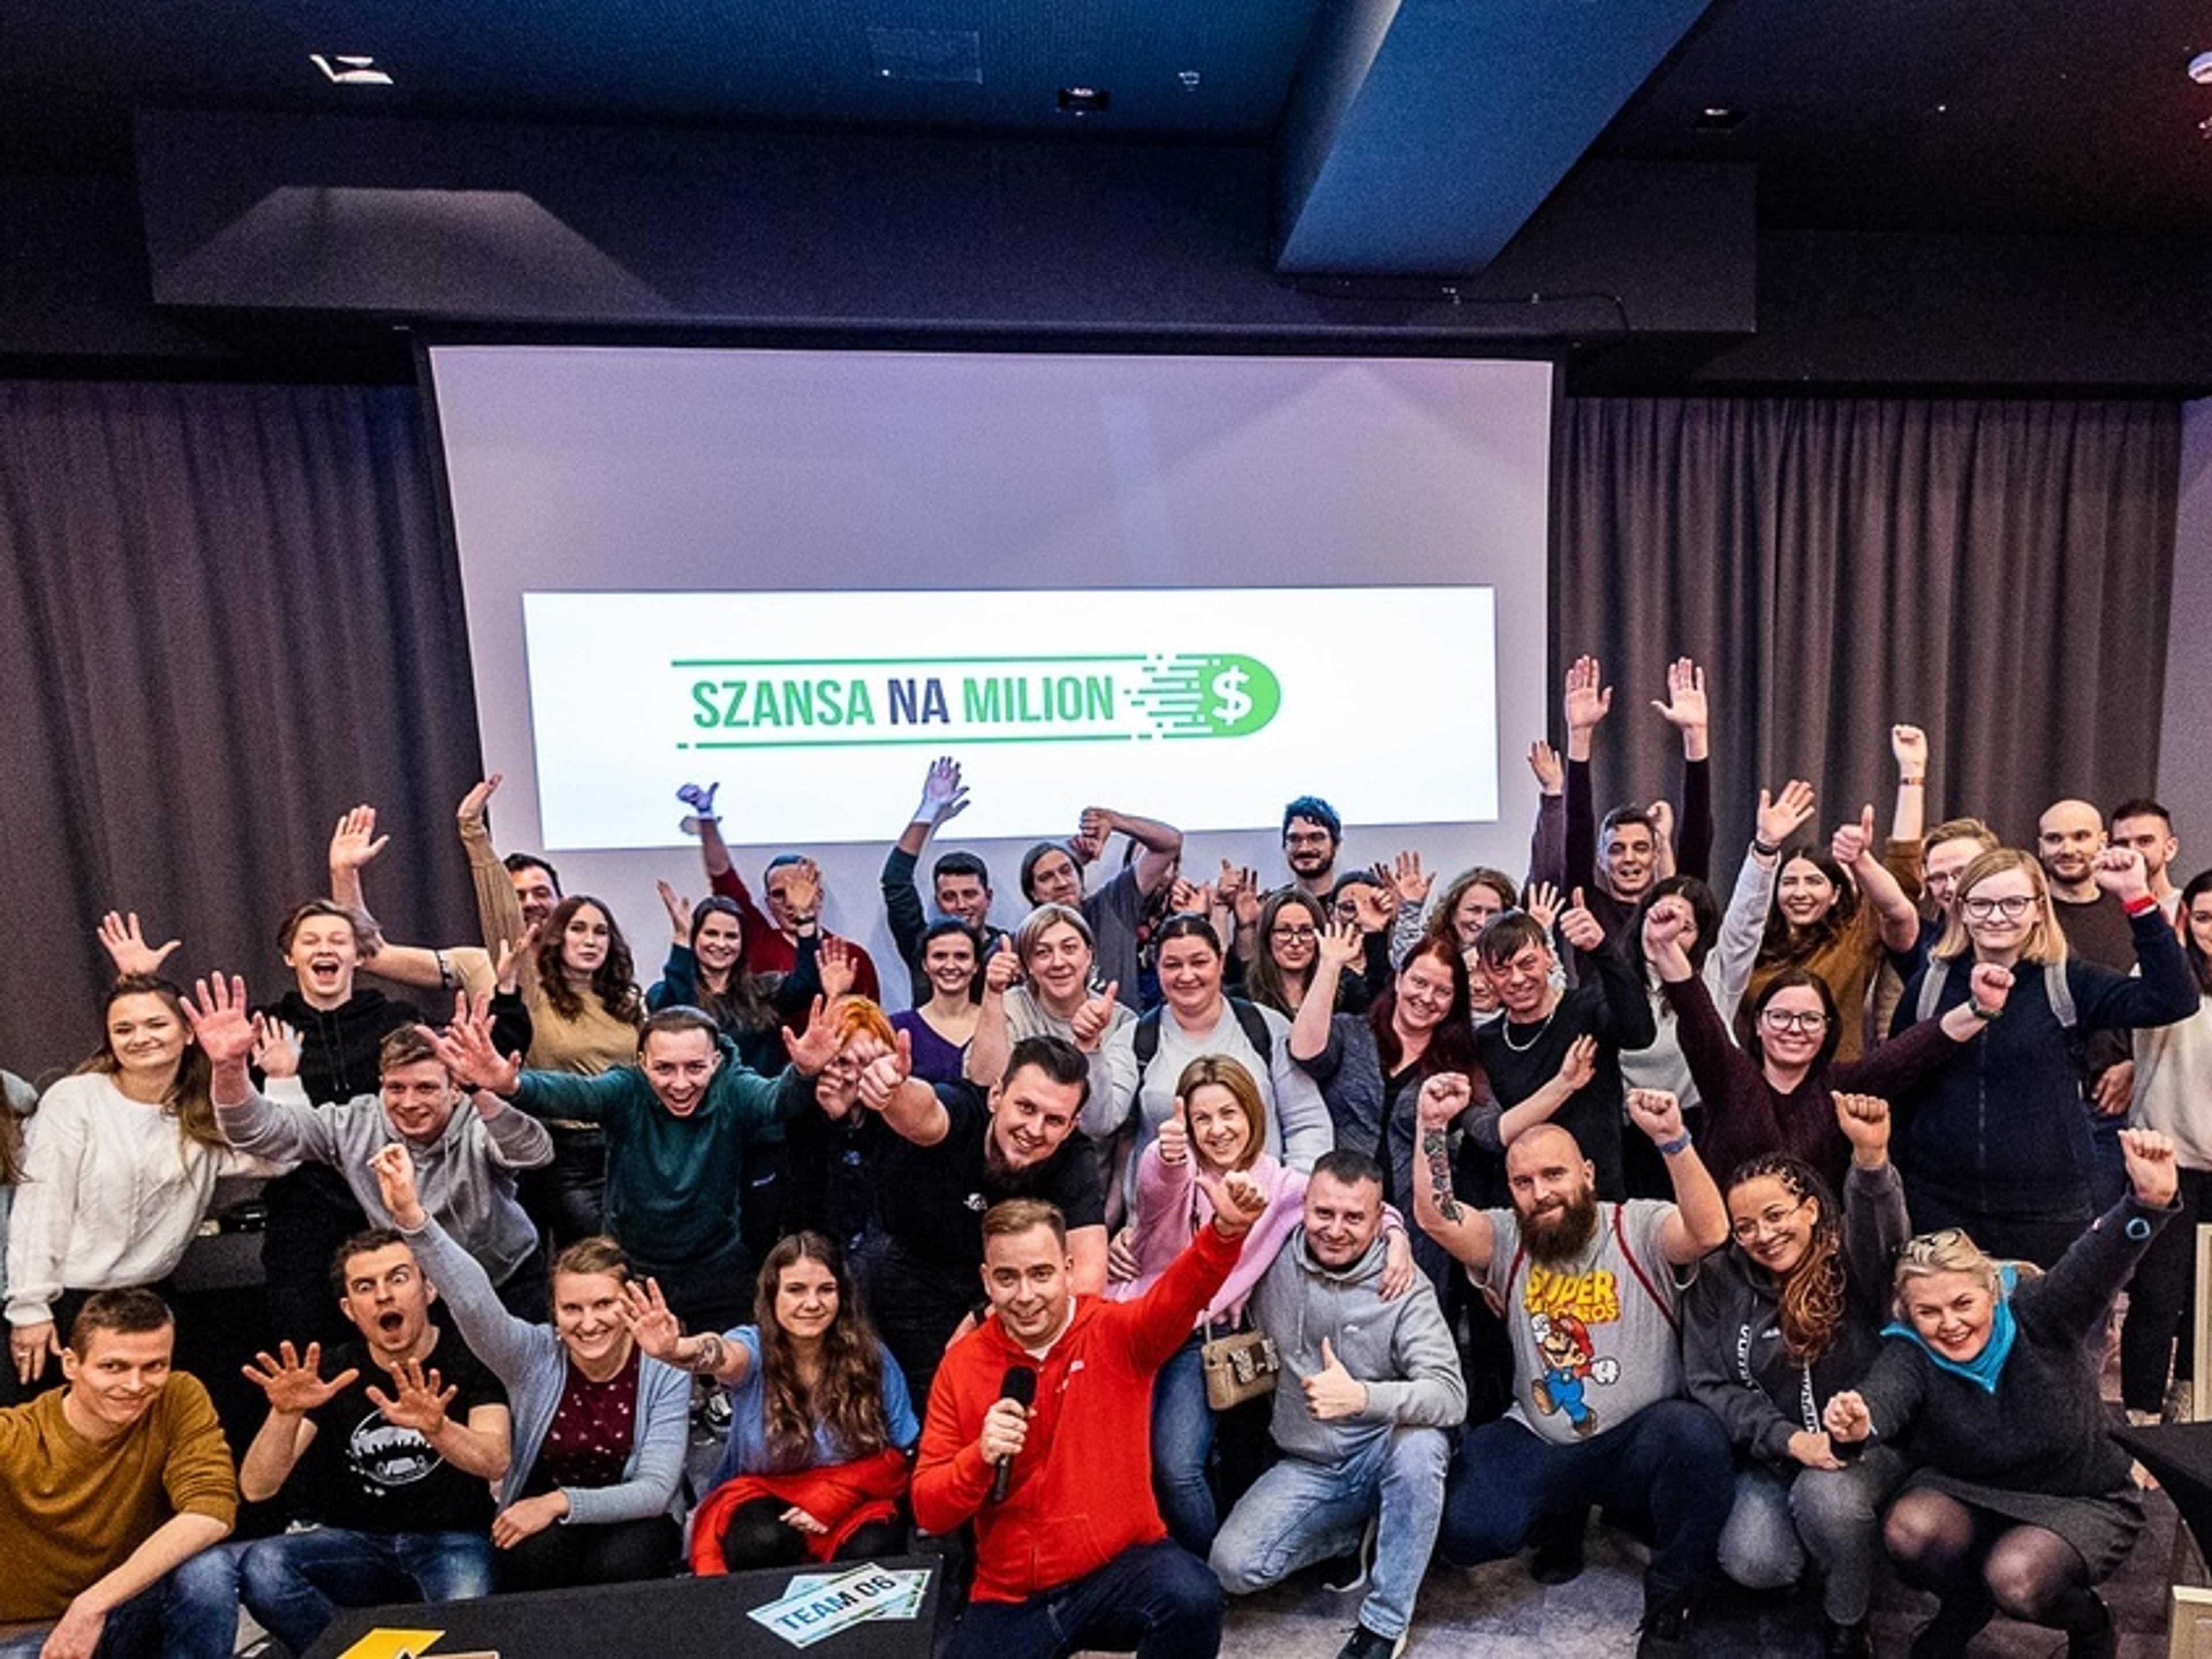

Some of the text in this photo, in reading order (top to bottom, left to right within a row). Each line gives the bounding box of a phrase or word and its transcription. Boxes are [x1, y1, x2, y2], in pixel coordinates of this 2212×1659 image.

[692, 679, 875, 728] SZANSA
[888, 677, 950, 725] NA
[963, 676, 1113, 722] MILION
[1527, 1264, 1616, 1305] SUPER
[777, 1590, 859, 1630] TEAM
